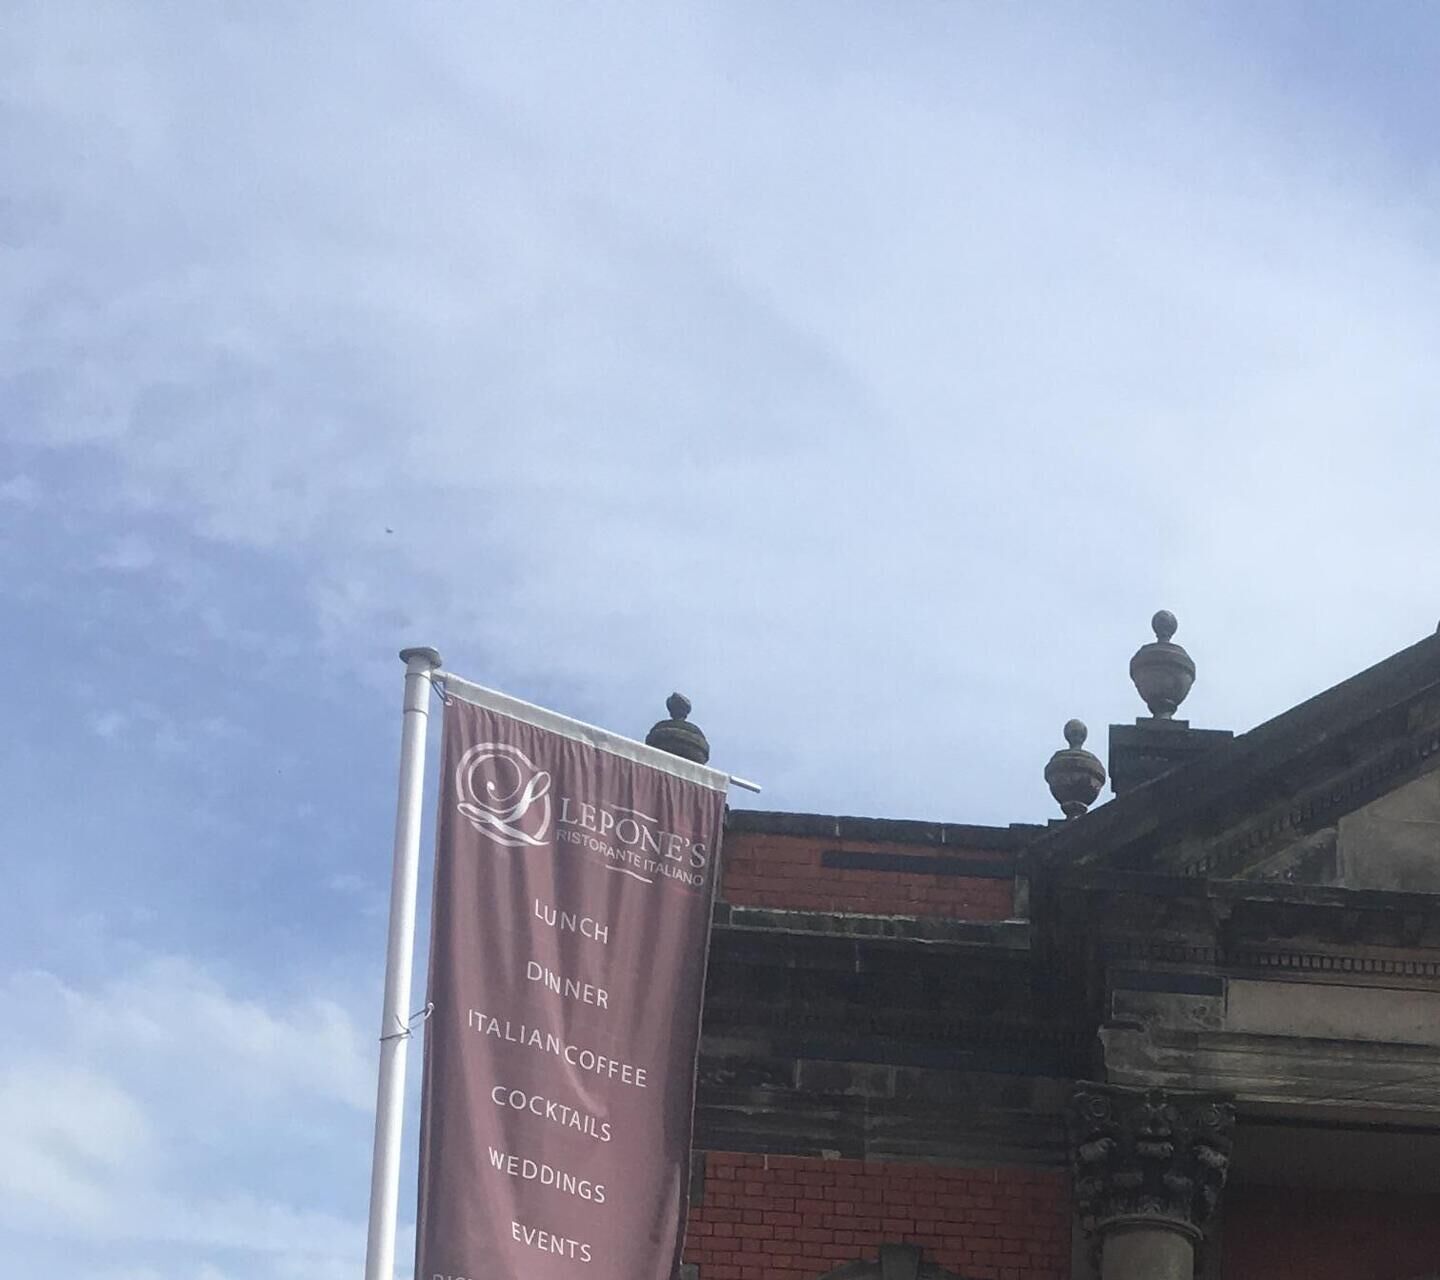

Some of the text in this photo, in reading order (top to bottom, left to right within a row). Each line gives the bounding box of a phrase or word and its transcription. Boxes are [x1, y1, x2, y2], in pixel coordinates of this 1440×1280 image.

[556, 829, 704, 886] RISTORANTE ITALIANO
[560, 797, 706, 868] LEPONE'S
[535, 898, 609, 944] LUNCH
[527, 961, 609, 1010] DINNER
[491, 1085, 612, 1142] COCKTAILS
[488, 1146, 606, 1204] WEDDINGS
[511, 1221, 592, 1263] EVENTS
